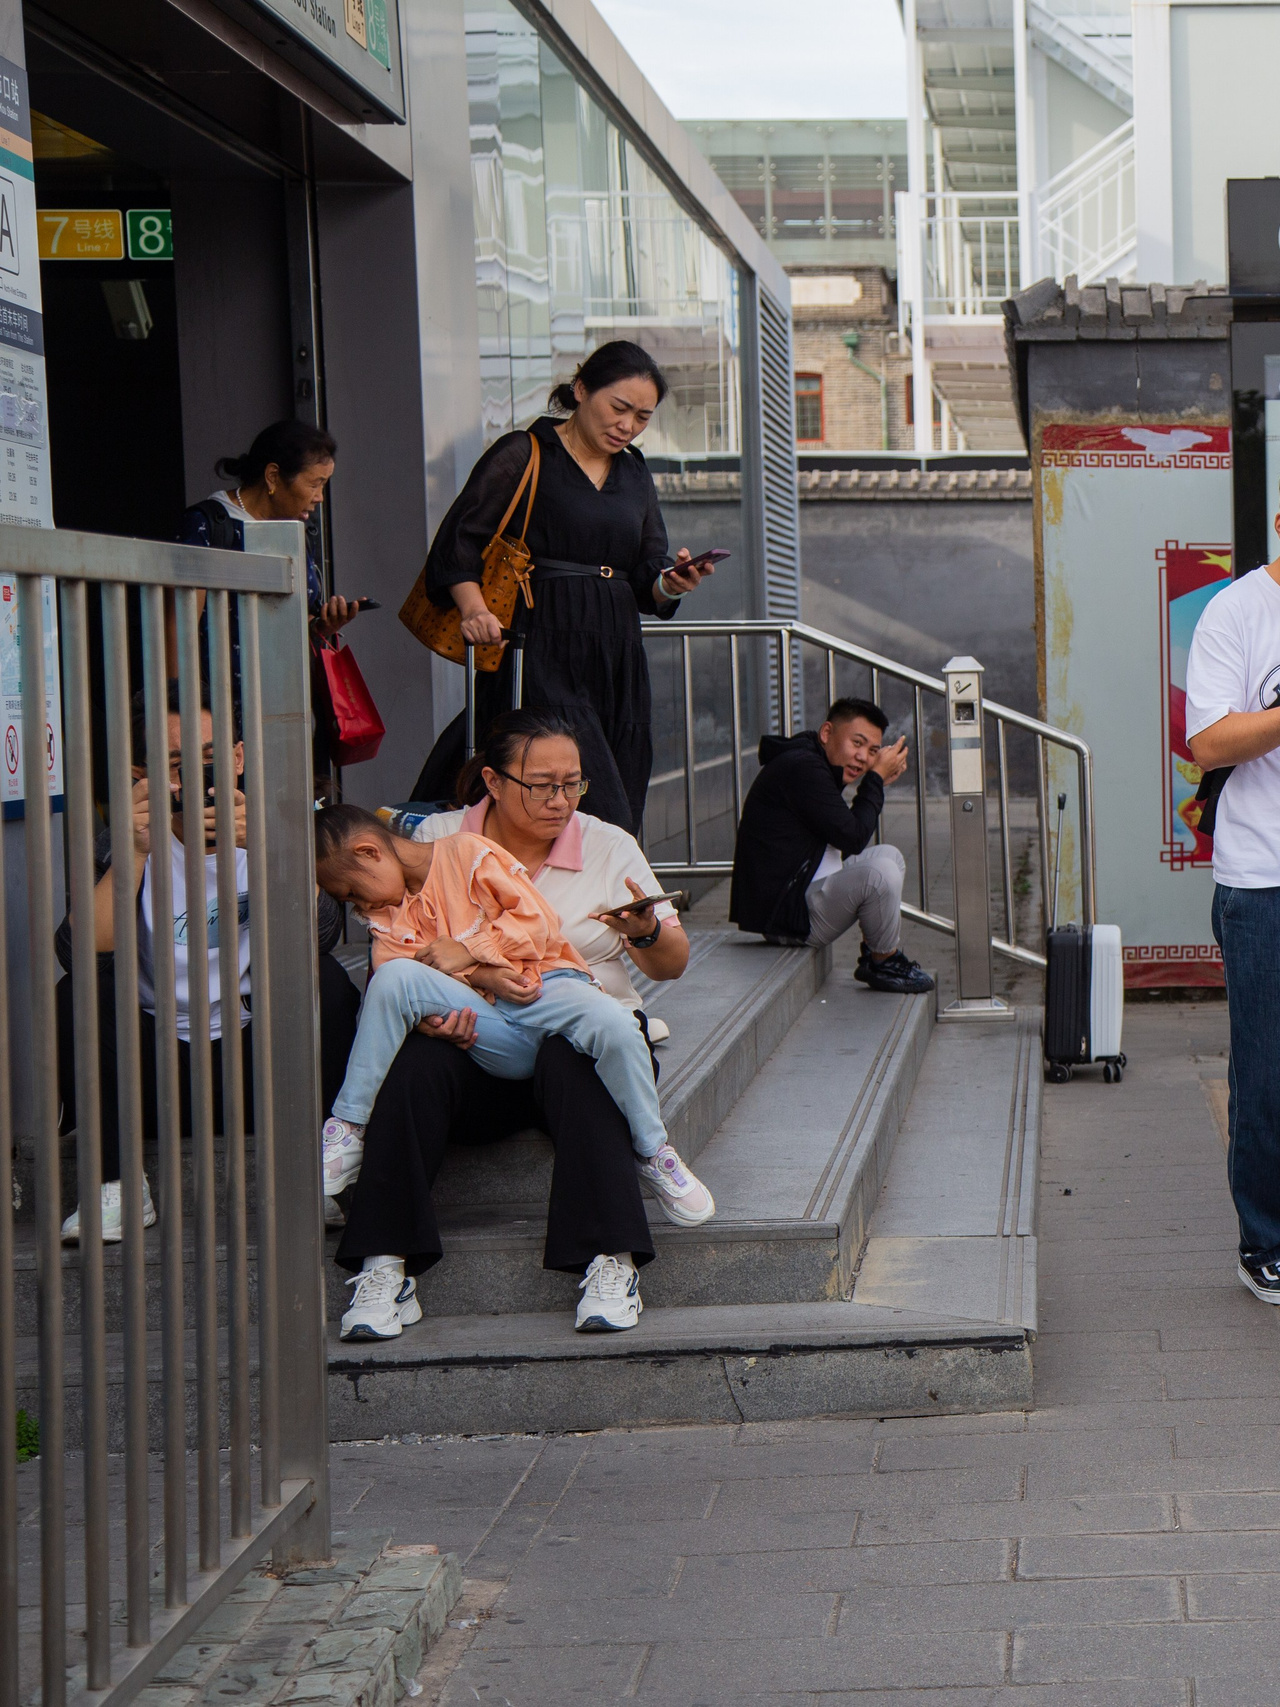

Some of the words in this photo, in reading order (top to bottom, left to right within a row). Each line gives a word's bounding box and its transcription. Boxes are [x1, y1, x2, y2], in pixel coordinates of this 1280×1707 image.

[311, 0, 337, 38] Station
[77, 243, 101, 252] Line
[104, 243, 110, 251] 7
